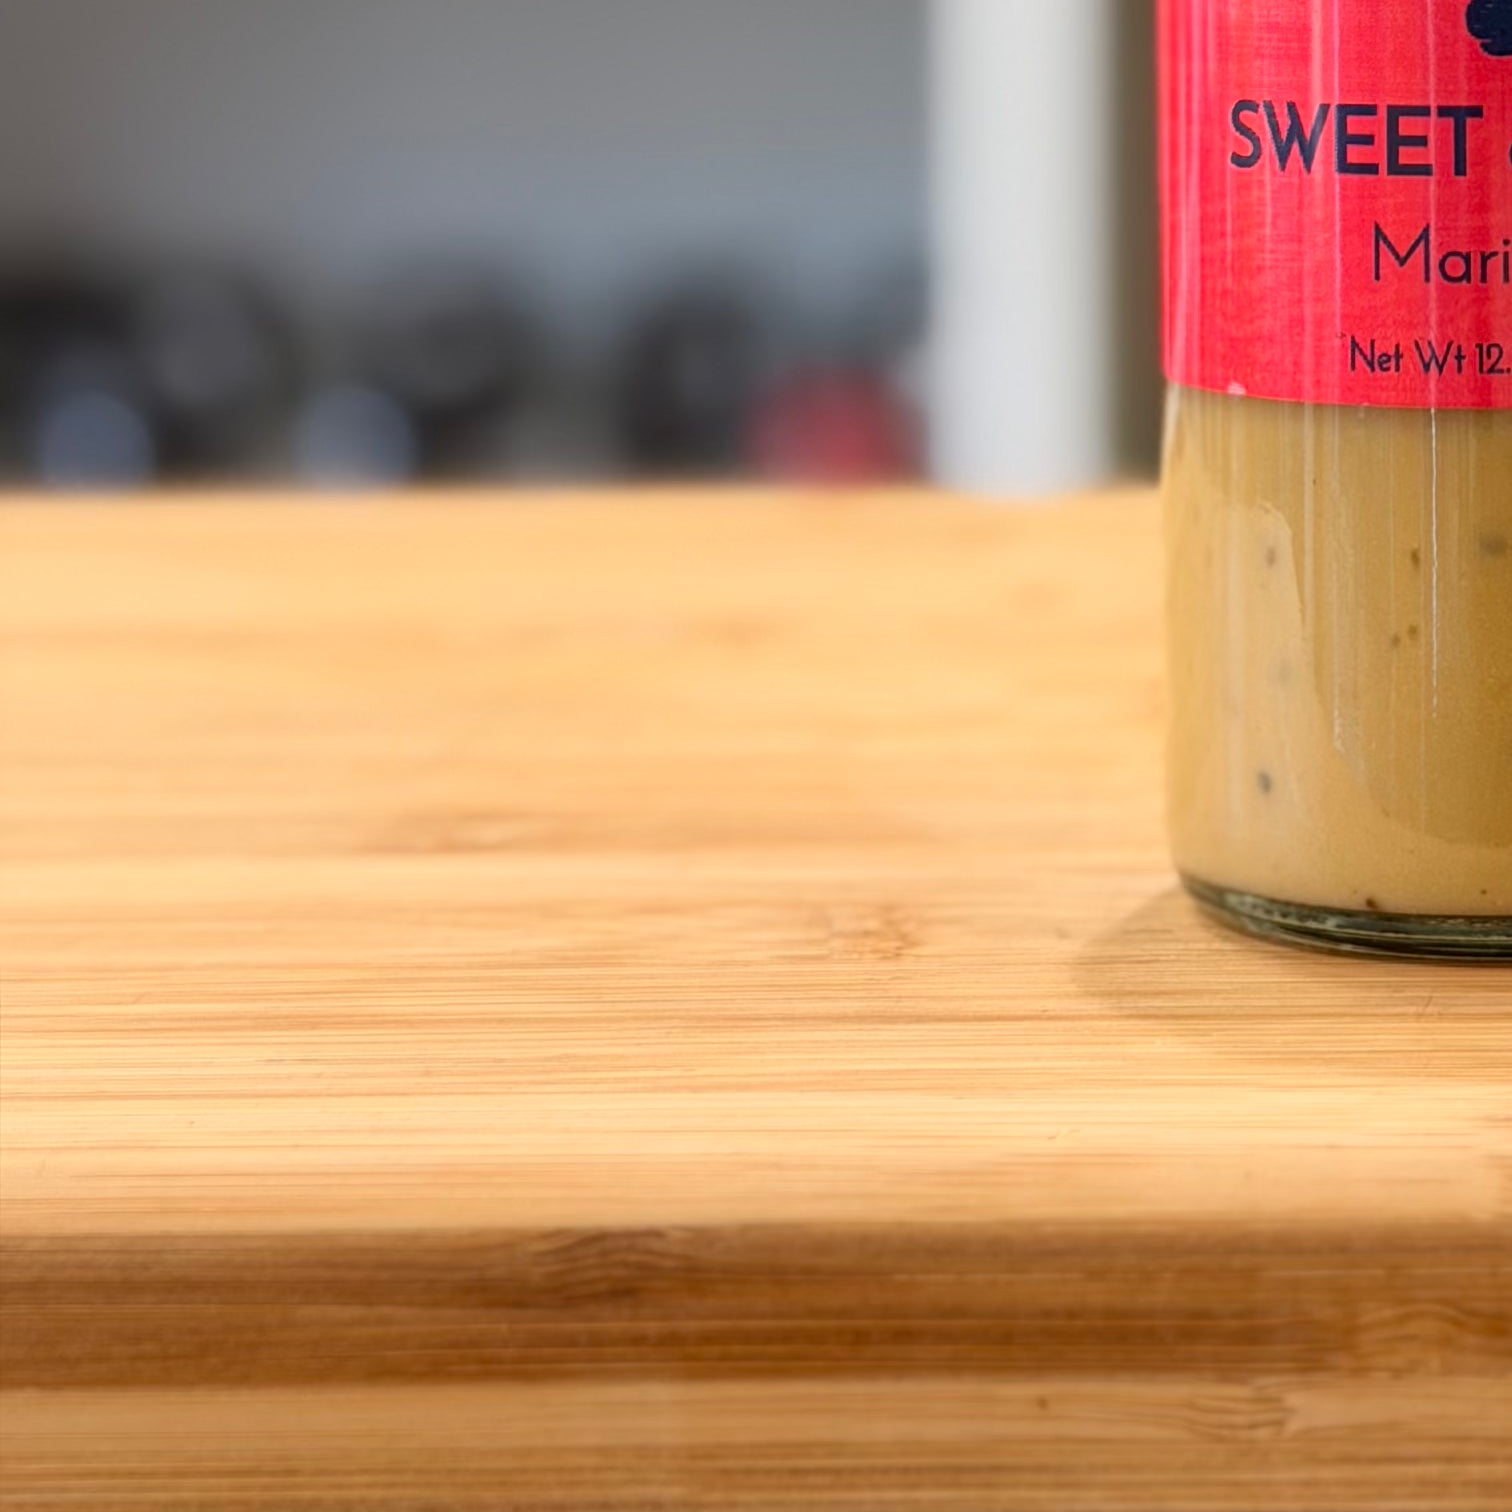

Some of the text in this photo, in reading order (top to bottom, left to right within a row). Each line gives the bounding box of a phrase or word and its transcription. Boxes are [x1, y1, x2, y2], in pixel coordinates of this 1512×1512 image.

[1230, 99, 1484, 177] SWEET
[1350, 335, 1403, 373] Net
[1413, 338, 1466, 376] Wt
